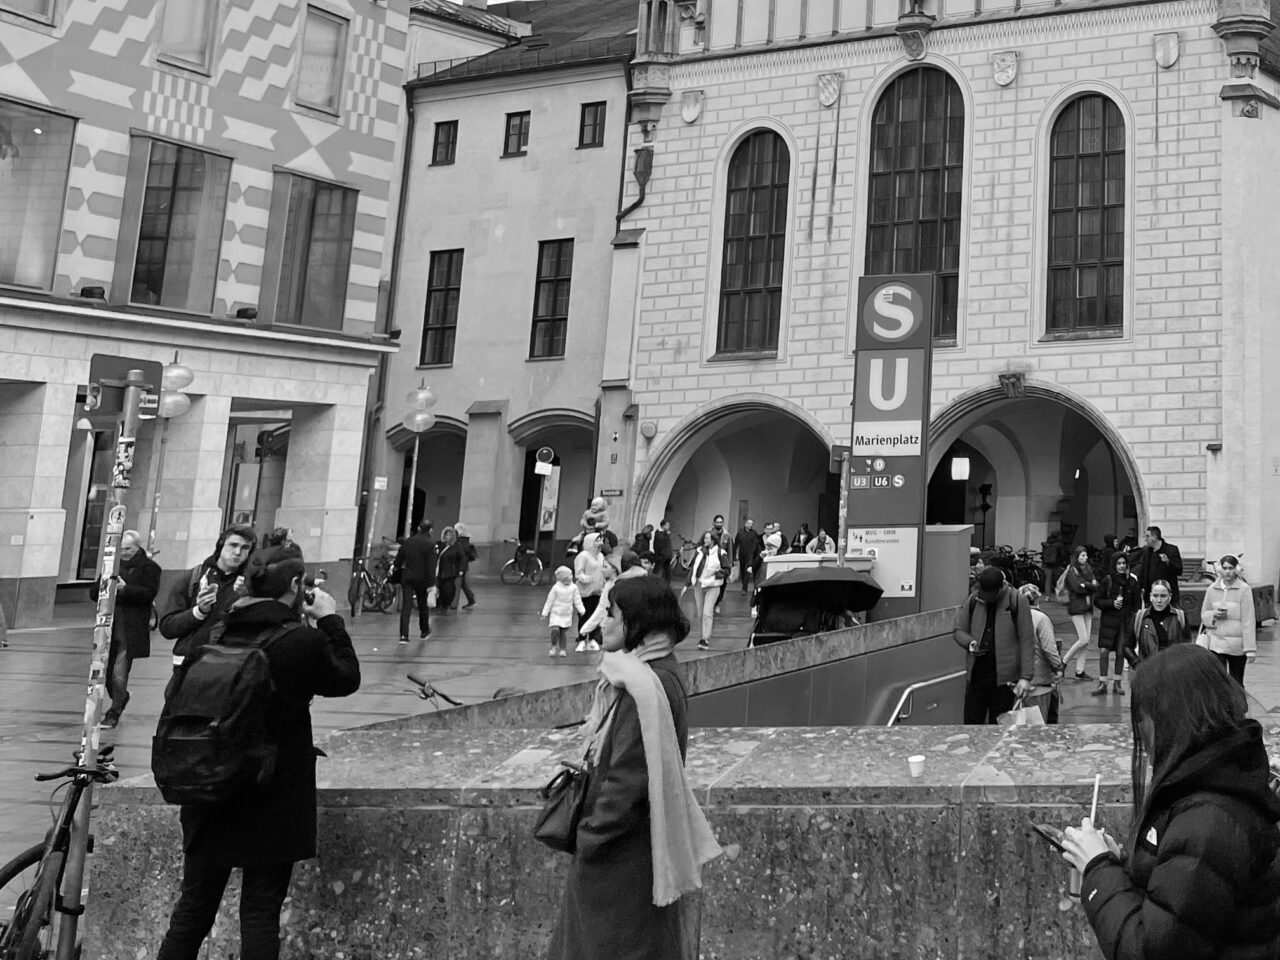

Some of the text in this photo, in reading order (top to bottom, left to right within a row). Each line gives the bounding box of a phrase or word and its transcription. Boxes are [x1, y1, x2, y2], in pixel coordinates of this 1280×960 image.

[873, 285, 914, 339] S
[868, 357, 909, 411] U
[855, 434, 920, 448] Marienplatz
[853, 475, 904, 487] U3 U6 S
